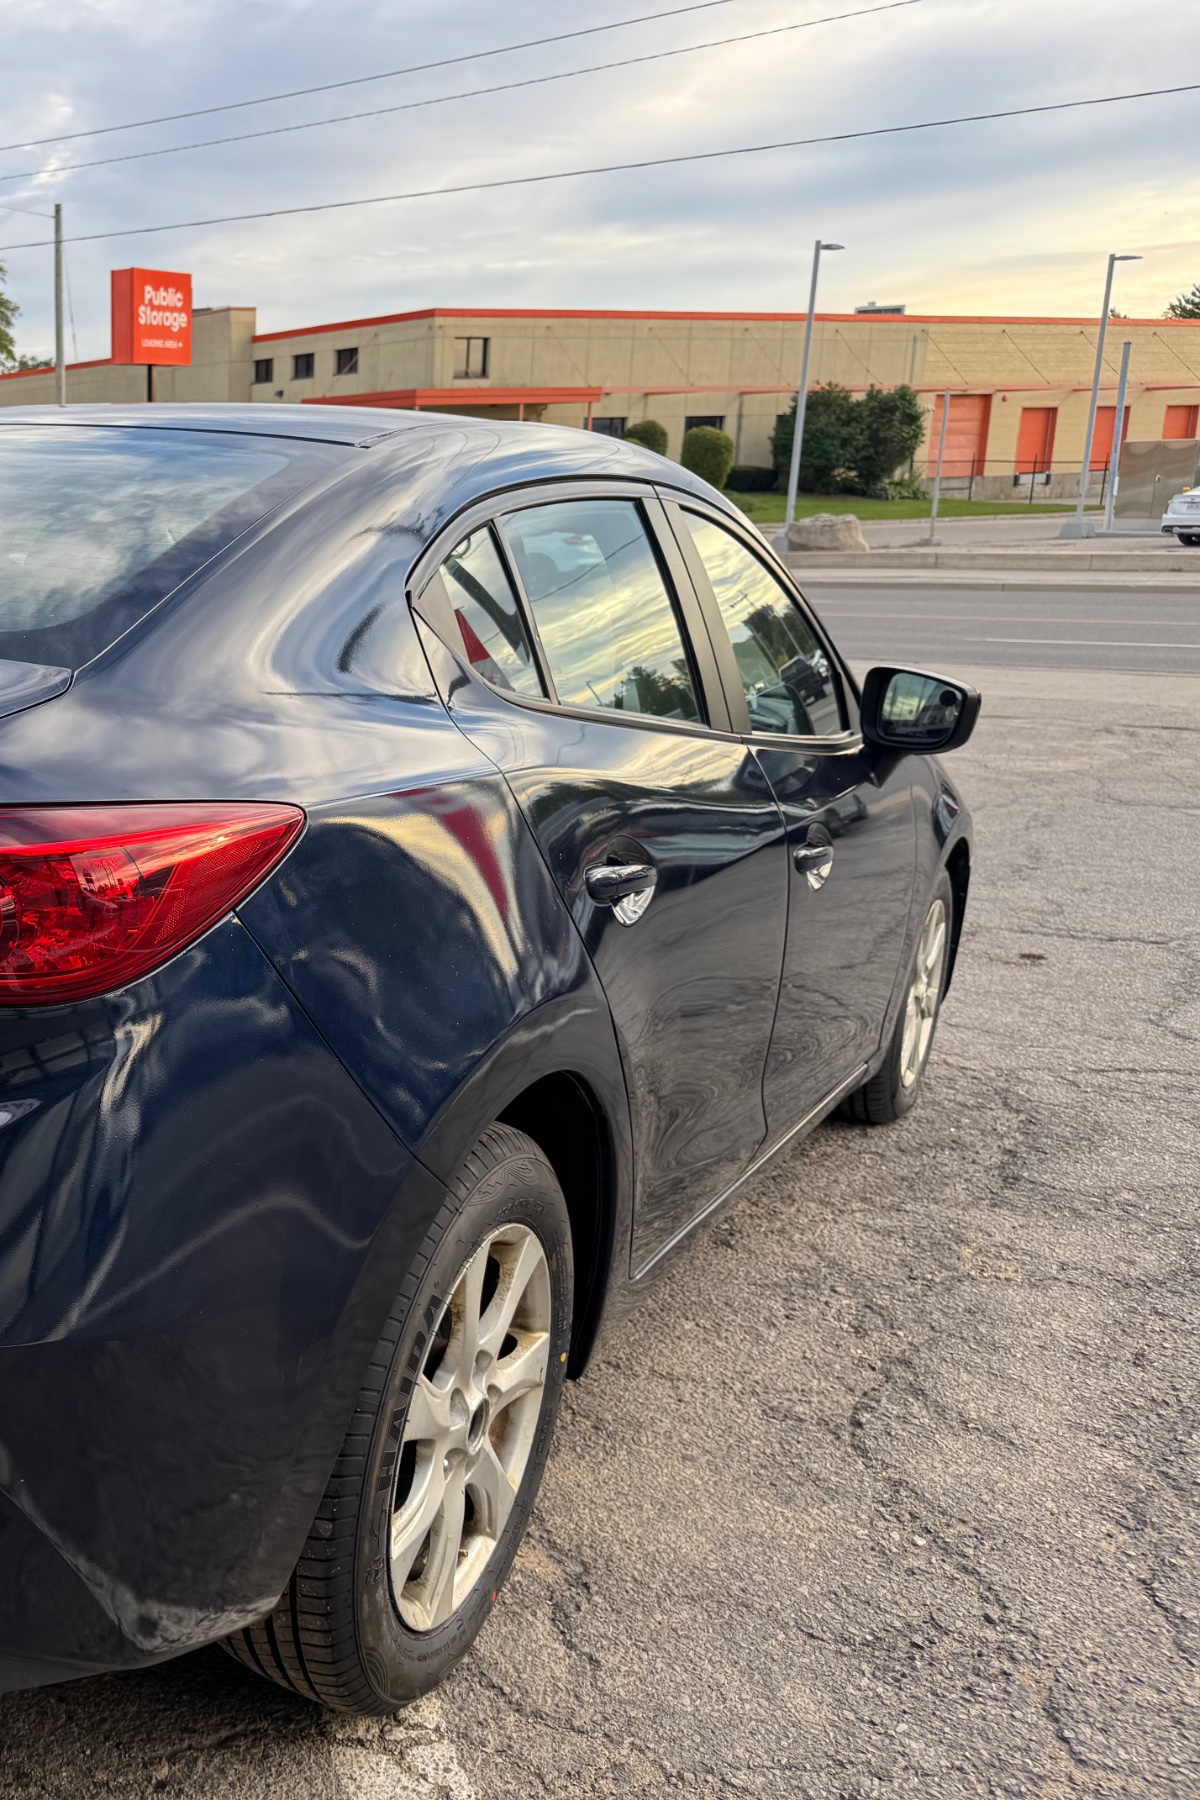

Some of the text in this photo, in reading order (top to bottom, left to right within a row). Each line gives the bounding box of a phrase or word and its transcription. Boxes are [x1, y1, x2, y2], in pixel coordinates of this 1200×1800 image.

[144, 285, 184, 308] Public
[138, 304, 188, 332] Storage
[378, 1294, 443, 1492] HAIDA
